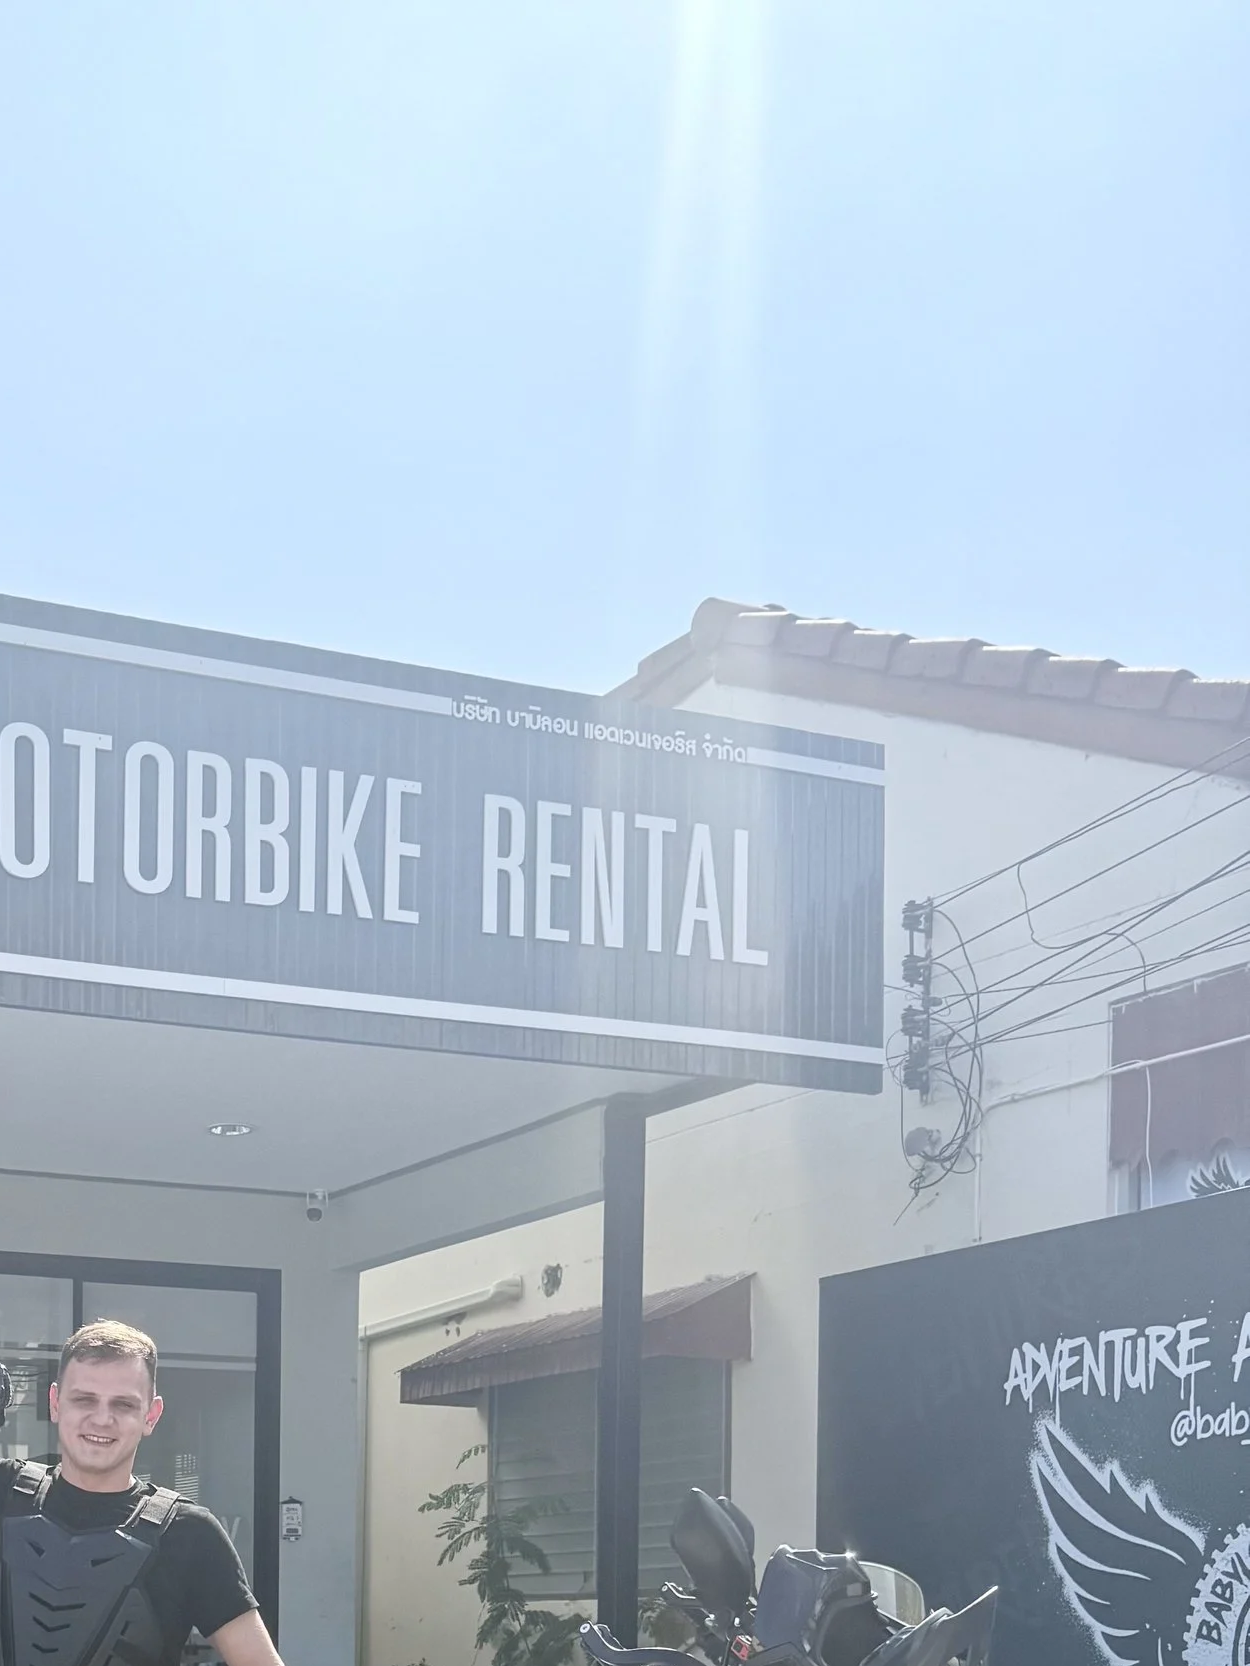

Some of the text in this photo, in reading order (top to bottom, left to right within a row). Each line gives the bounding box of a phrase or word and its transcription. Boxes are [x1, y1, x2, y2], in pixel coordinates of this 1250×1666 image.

[452, 695, 501, 724] บริษัท
[507, 705, 579, 737] บาบิลอน
[702, 732, 749, 764] จำกัด
[481, 792, 769, 967] RENTAL
[1003, 1317, 1212, 1414] ADVENTURE
